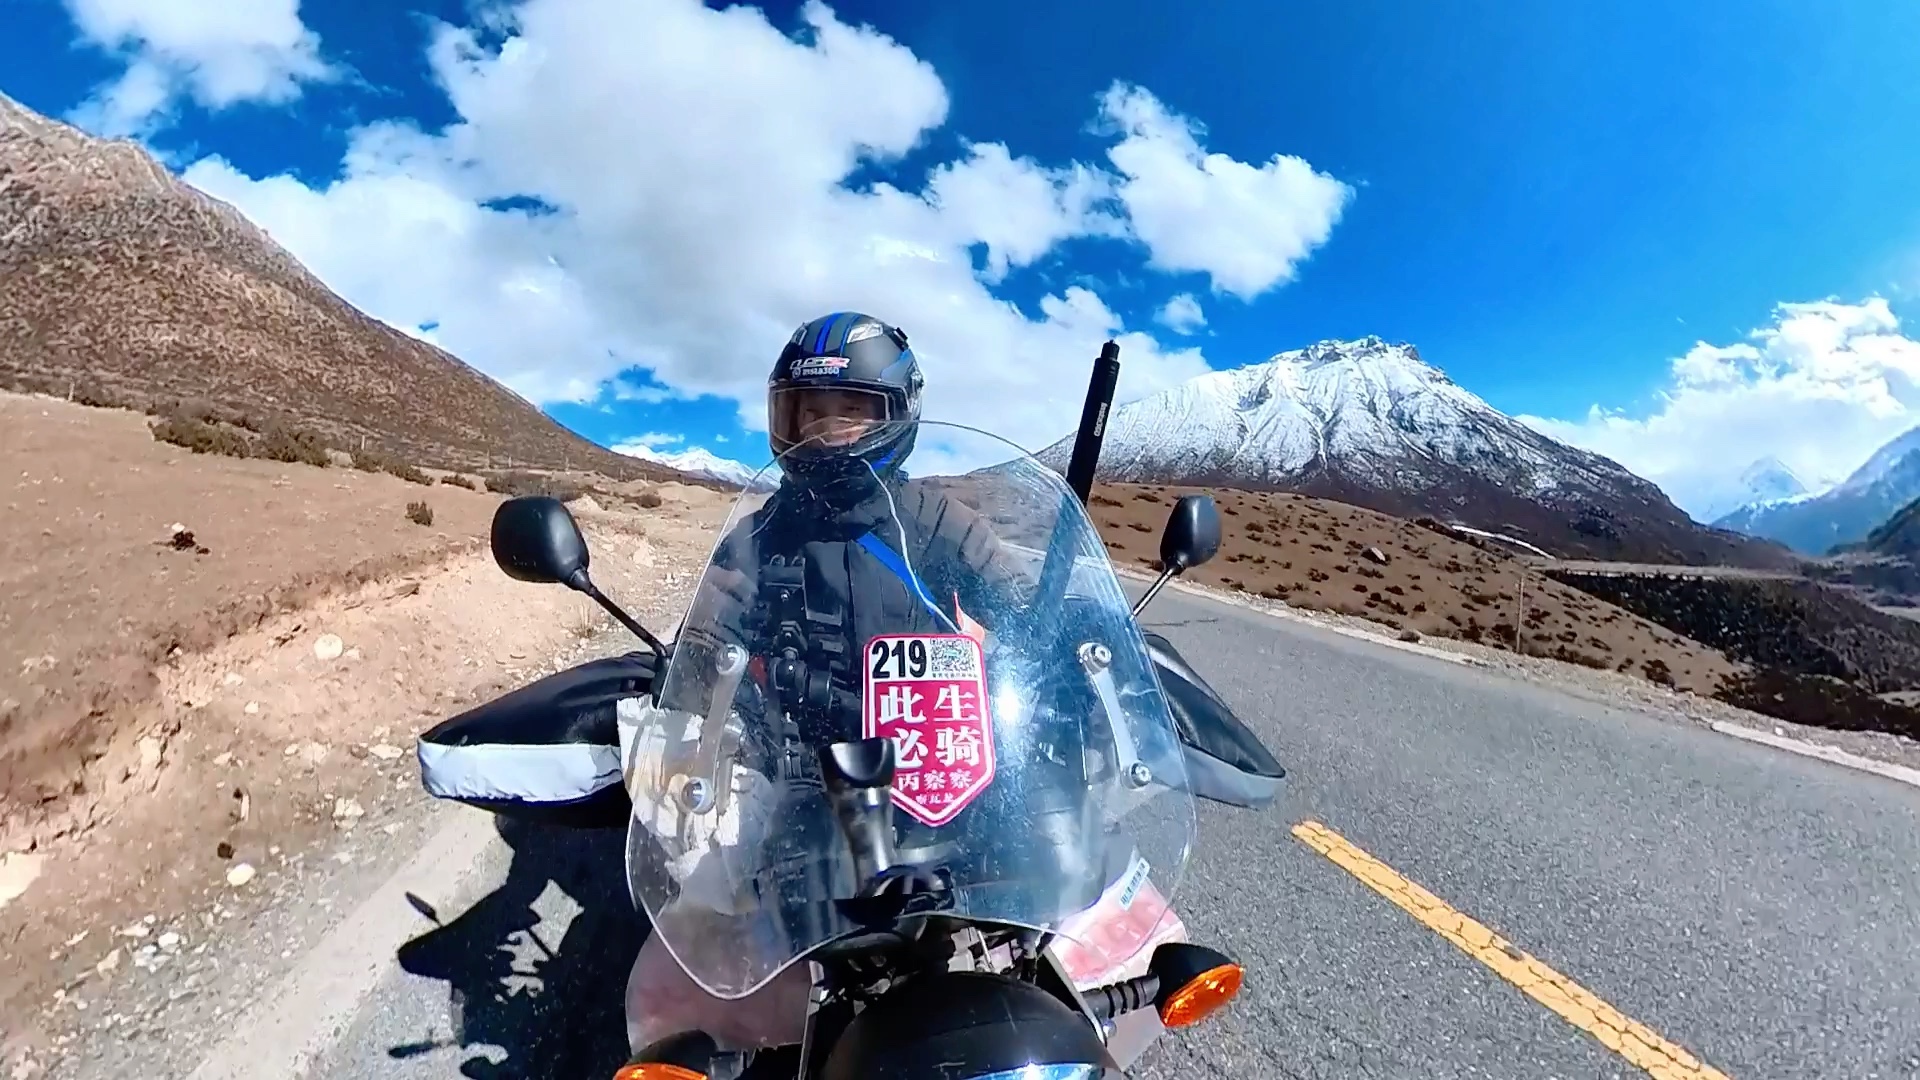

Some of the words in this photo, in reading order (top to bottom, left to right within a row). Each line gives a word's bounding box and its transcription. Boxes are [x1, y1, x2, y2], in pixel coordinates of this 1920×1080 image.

[871, 639, 927, 679] 219
[878, 684, 980, 725] 此生
[894, 725, 981, 769] 必骑
[897, 768, 973, 791] 丙察察
